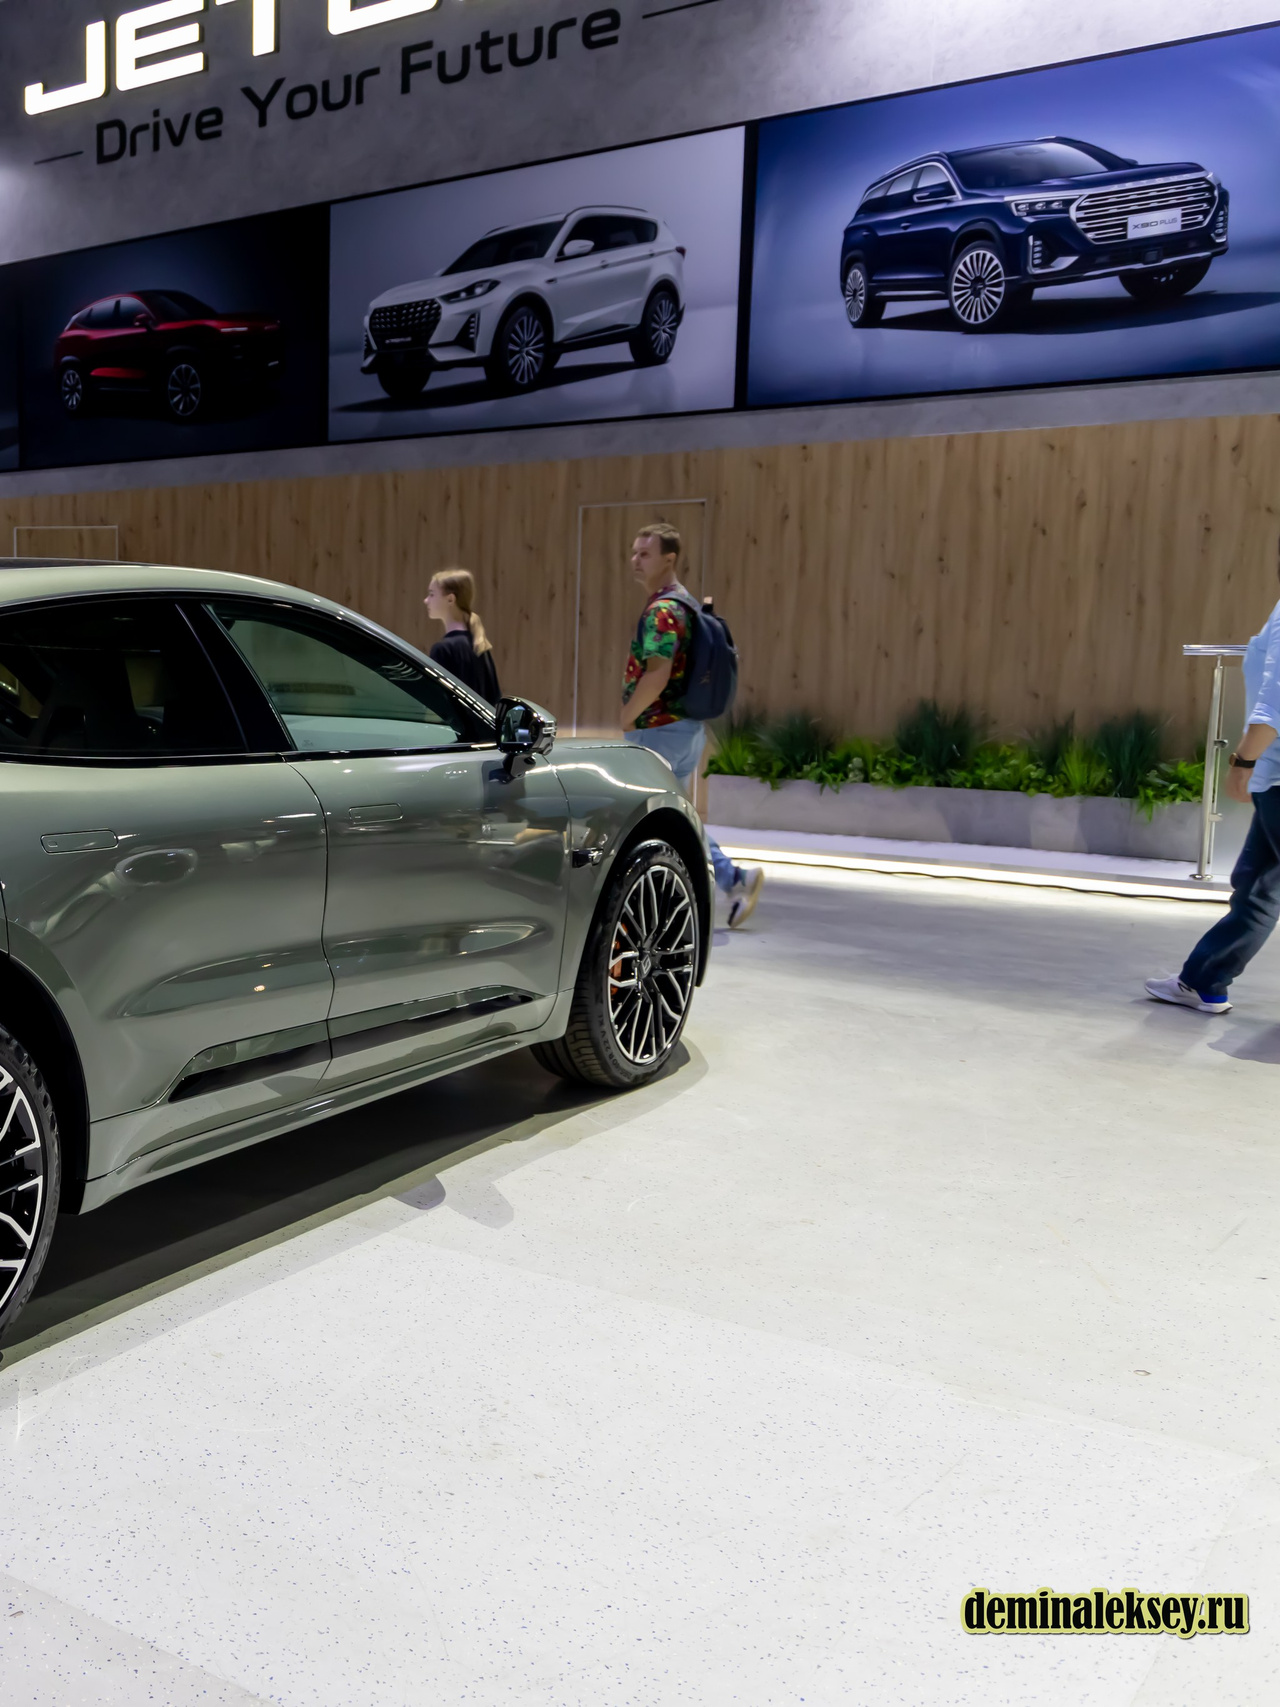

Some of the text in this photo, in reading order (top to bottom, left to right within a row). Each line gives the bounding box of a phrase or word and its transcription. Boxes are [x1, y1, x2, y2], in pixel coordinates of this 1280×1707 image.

[25, 0, 465, 115] JET
[96, 9, 621, 165] Drive Your Future
[1160, 217, 1178, 225] PLUS
